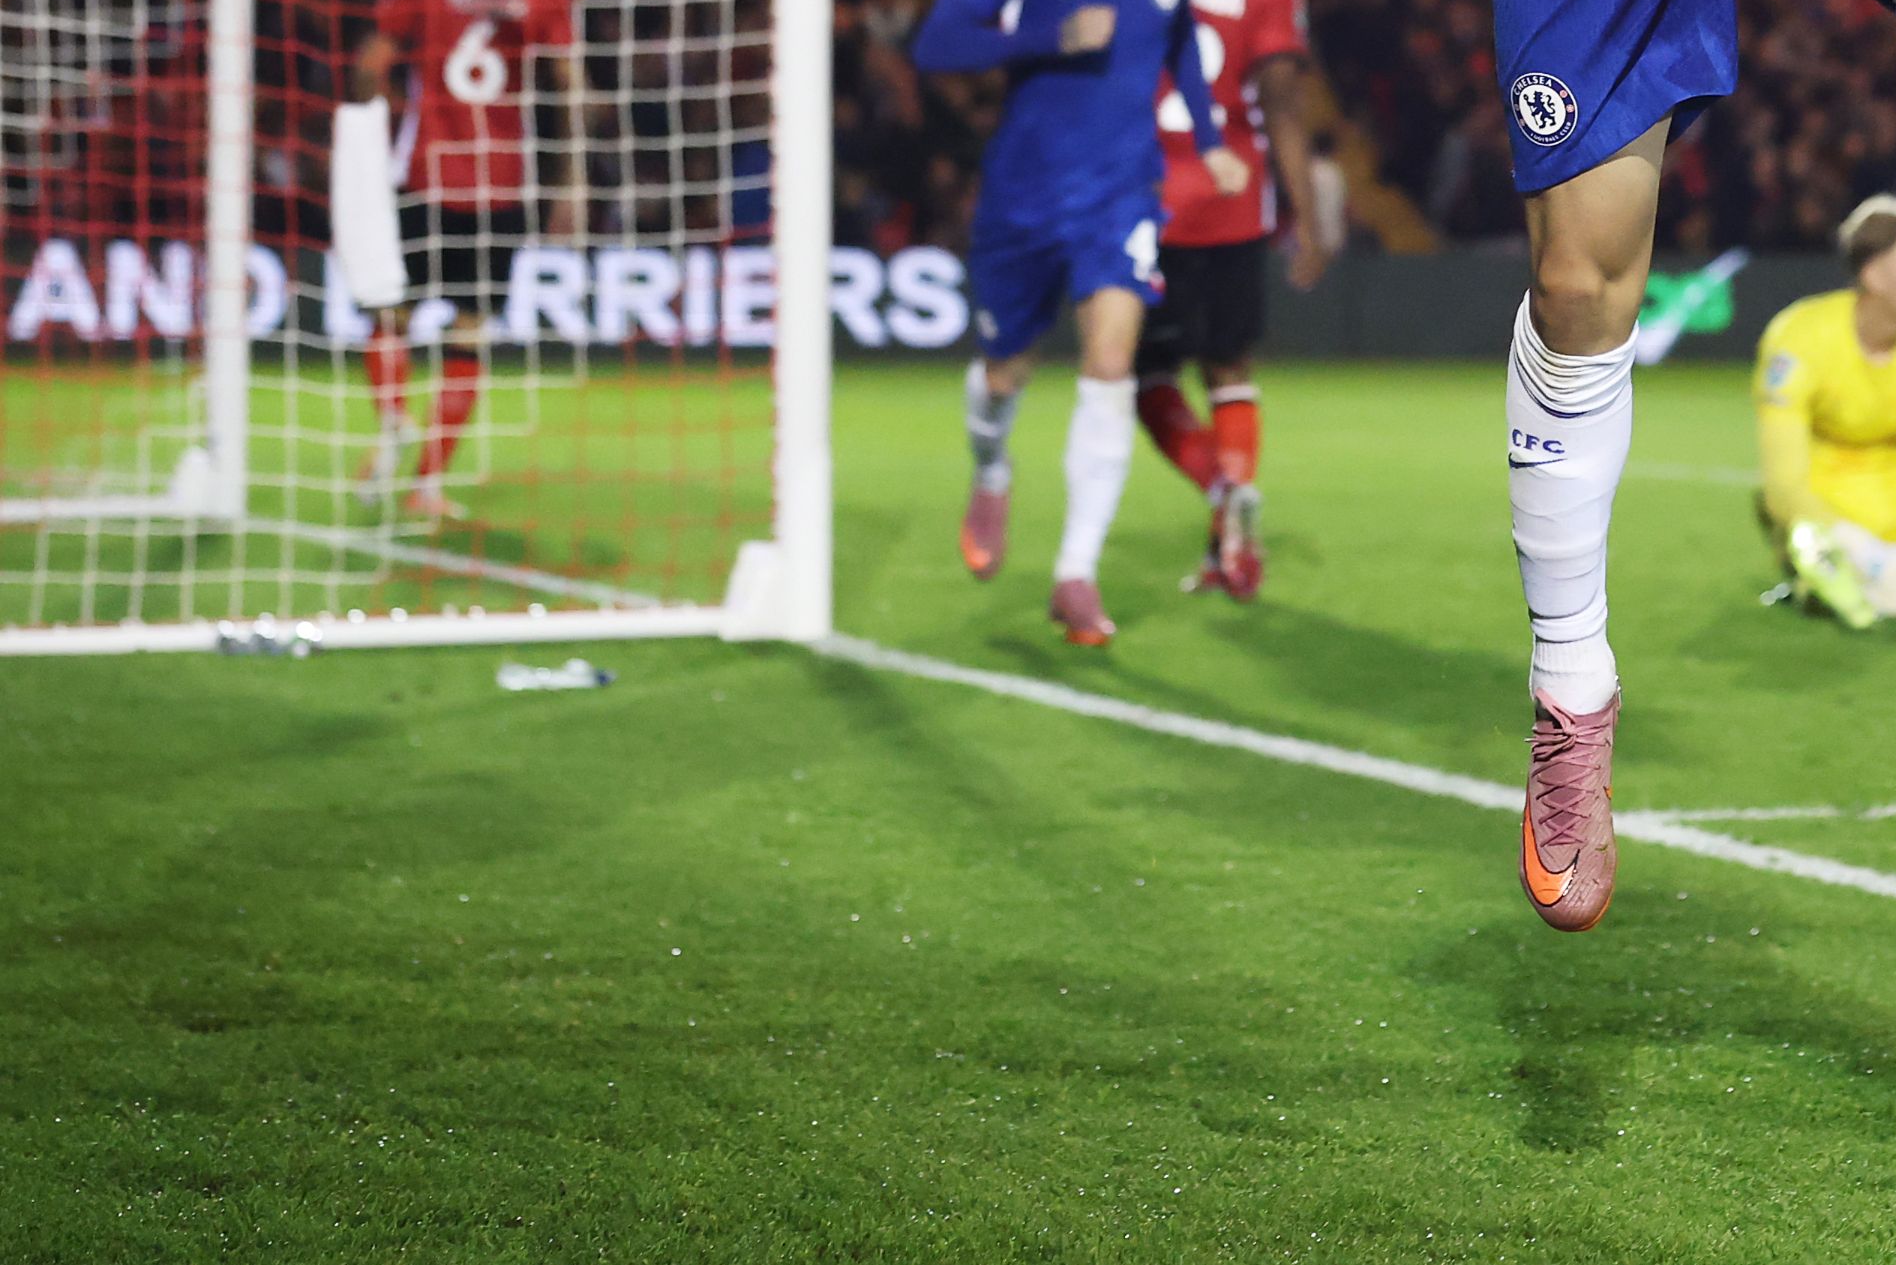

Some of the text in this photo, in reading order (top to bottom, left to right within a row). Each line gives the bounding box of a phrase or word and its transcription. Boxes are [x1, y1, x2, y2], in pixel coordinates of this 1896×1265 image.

[443, 17, 509, 106] 6
[1513, 75, 1553, 96] CHELSEA
[1511, 428, 1566, 454] CFC
